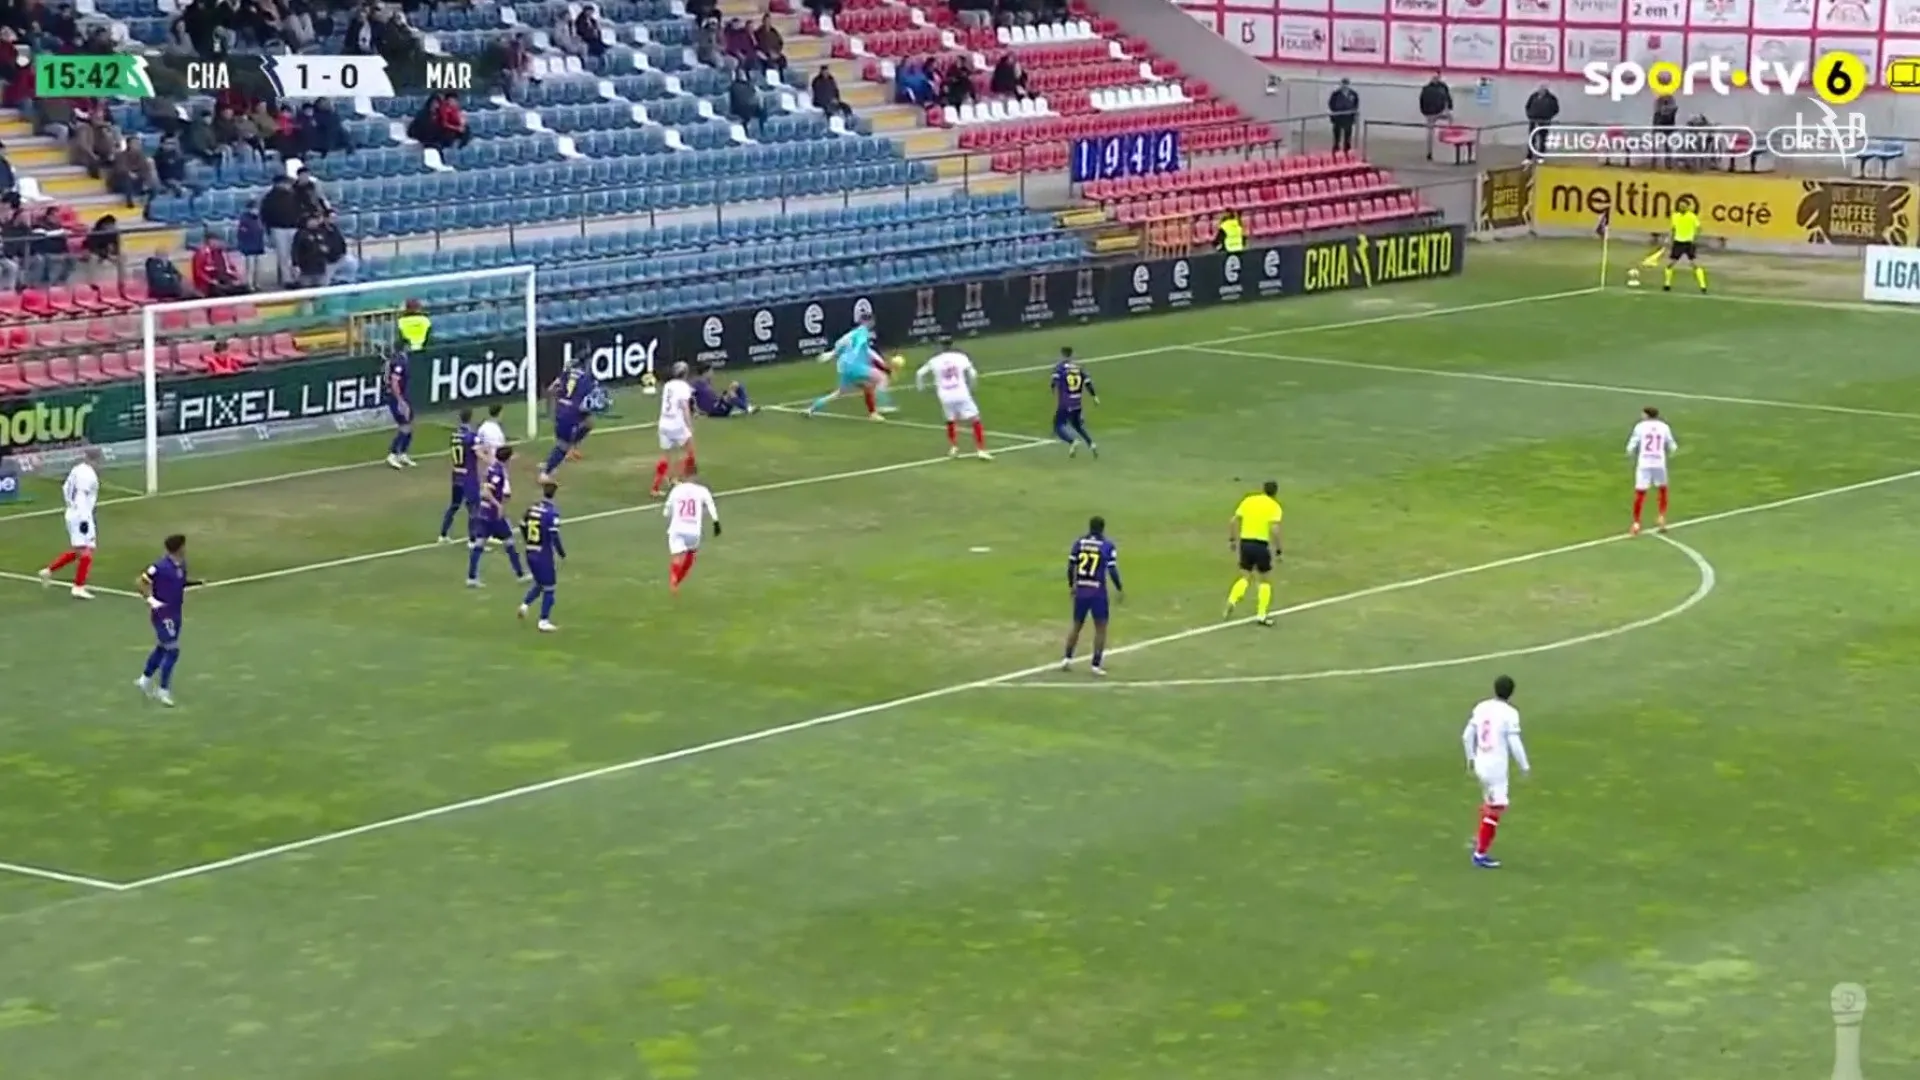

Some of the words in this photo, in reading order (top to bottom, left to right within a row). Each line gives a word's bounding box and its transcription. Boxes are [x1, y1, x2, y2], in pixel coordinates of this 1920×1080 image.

[1081, 133, 1172, 178] 1949
[1711, 202, 1772, 227] café
[1830, 220, 1876, 237] MAKERS
[1831, 204, 1877, 220] COFFEE
[1304, 244, 1348, 290] CRIA
[1376, 231, 1452, 280] TALENTO
[431, 350, 529, 403] Haier
[180, 388, 290, 431] PIXEL
[301, 375, 384, 415] LIGH
[1077, 552, 1100, 577] 27
